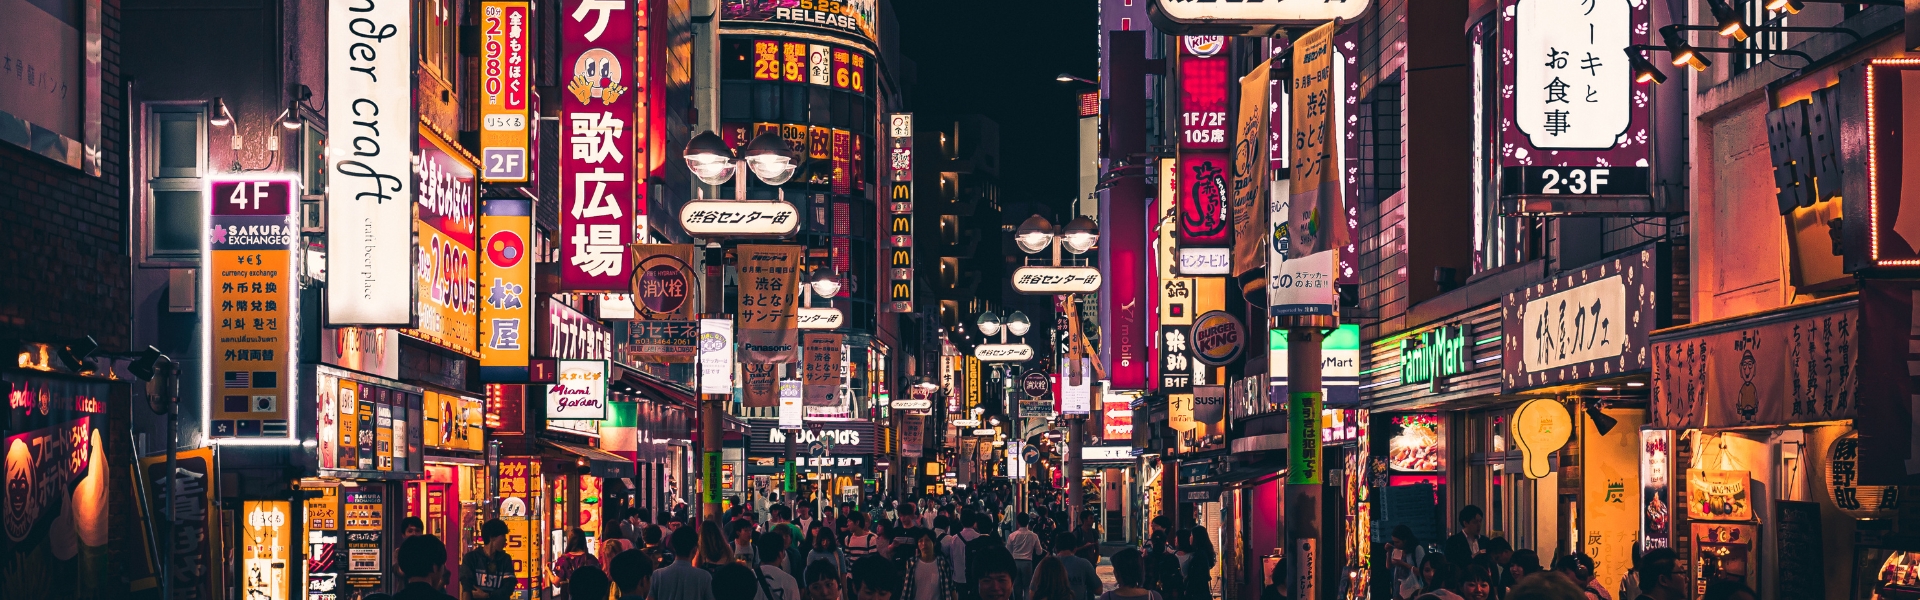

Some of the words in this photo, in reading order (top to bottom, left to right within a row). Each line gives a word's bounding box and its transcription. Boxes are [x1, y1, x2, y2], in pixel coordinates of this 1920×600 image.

[776, 7, 856, 31] RELEASE
[508, 10, 522, 106] 全身もみほぐし
[1543, 47, 1572, 137] お食事
[1307, 89, 1329, 120] 渋谷
[487, 116, 522, 127] りらくる
[1183, 112, 1226, 127] 1F/2F
[1185, 129, 1225, 143] 105席
[490, 153, 520, 173] 2F
[229, 181, 271, 210] 4F
[570, 110, 625, 278] 歌広場
[686, 210, 792, 225] 渋谷センター街
[228, 225, 290, 236] SAKURA
[1180, 254, 1229, 269] センタービル
[221, 270, 247, 278] currency
[249, 269, 278, 278] exchange
[1018, 274, 1098, 286] 渋谷センター街
[1271, 273, 1293, 289] この
[222, 282, 277, 294] 外币兑换
[643, 279, 683, 297] 消火栓
[755, 277, 783, 291] 渋谷
[1165, 280, 1189, 299] 鍋
[742, 293, 795, 307] おとなり
[487, 277, 524, 351] 松屋
[742, 309, 795, 323] サンデー
[221, 317, 246, 330] 외화
[252, 317, 278, 330] 환전
[646, 322, 693, 338] セキネ
[1198, 322, 1236, 338] BURGER
[745, 343, 792, 352] Panasonic
[1200, 330, 1238, 353] KING
[224, 349, 275, 361] 外貨両替
[1400, 324, 1465, 393] FamilyMart
[805, 363, 839, 372] おとなり
[805, 373, 839, 381] サンデー
[1164, 377, 1188, 388] B1F
[548, 384, 592, 396] Miami
[1026, 380, 1046, 391] 消火栓
[75, 394, 107, 413] Kitchen
[1195, 396, 1224, 405] SUSHI
